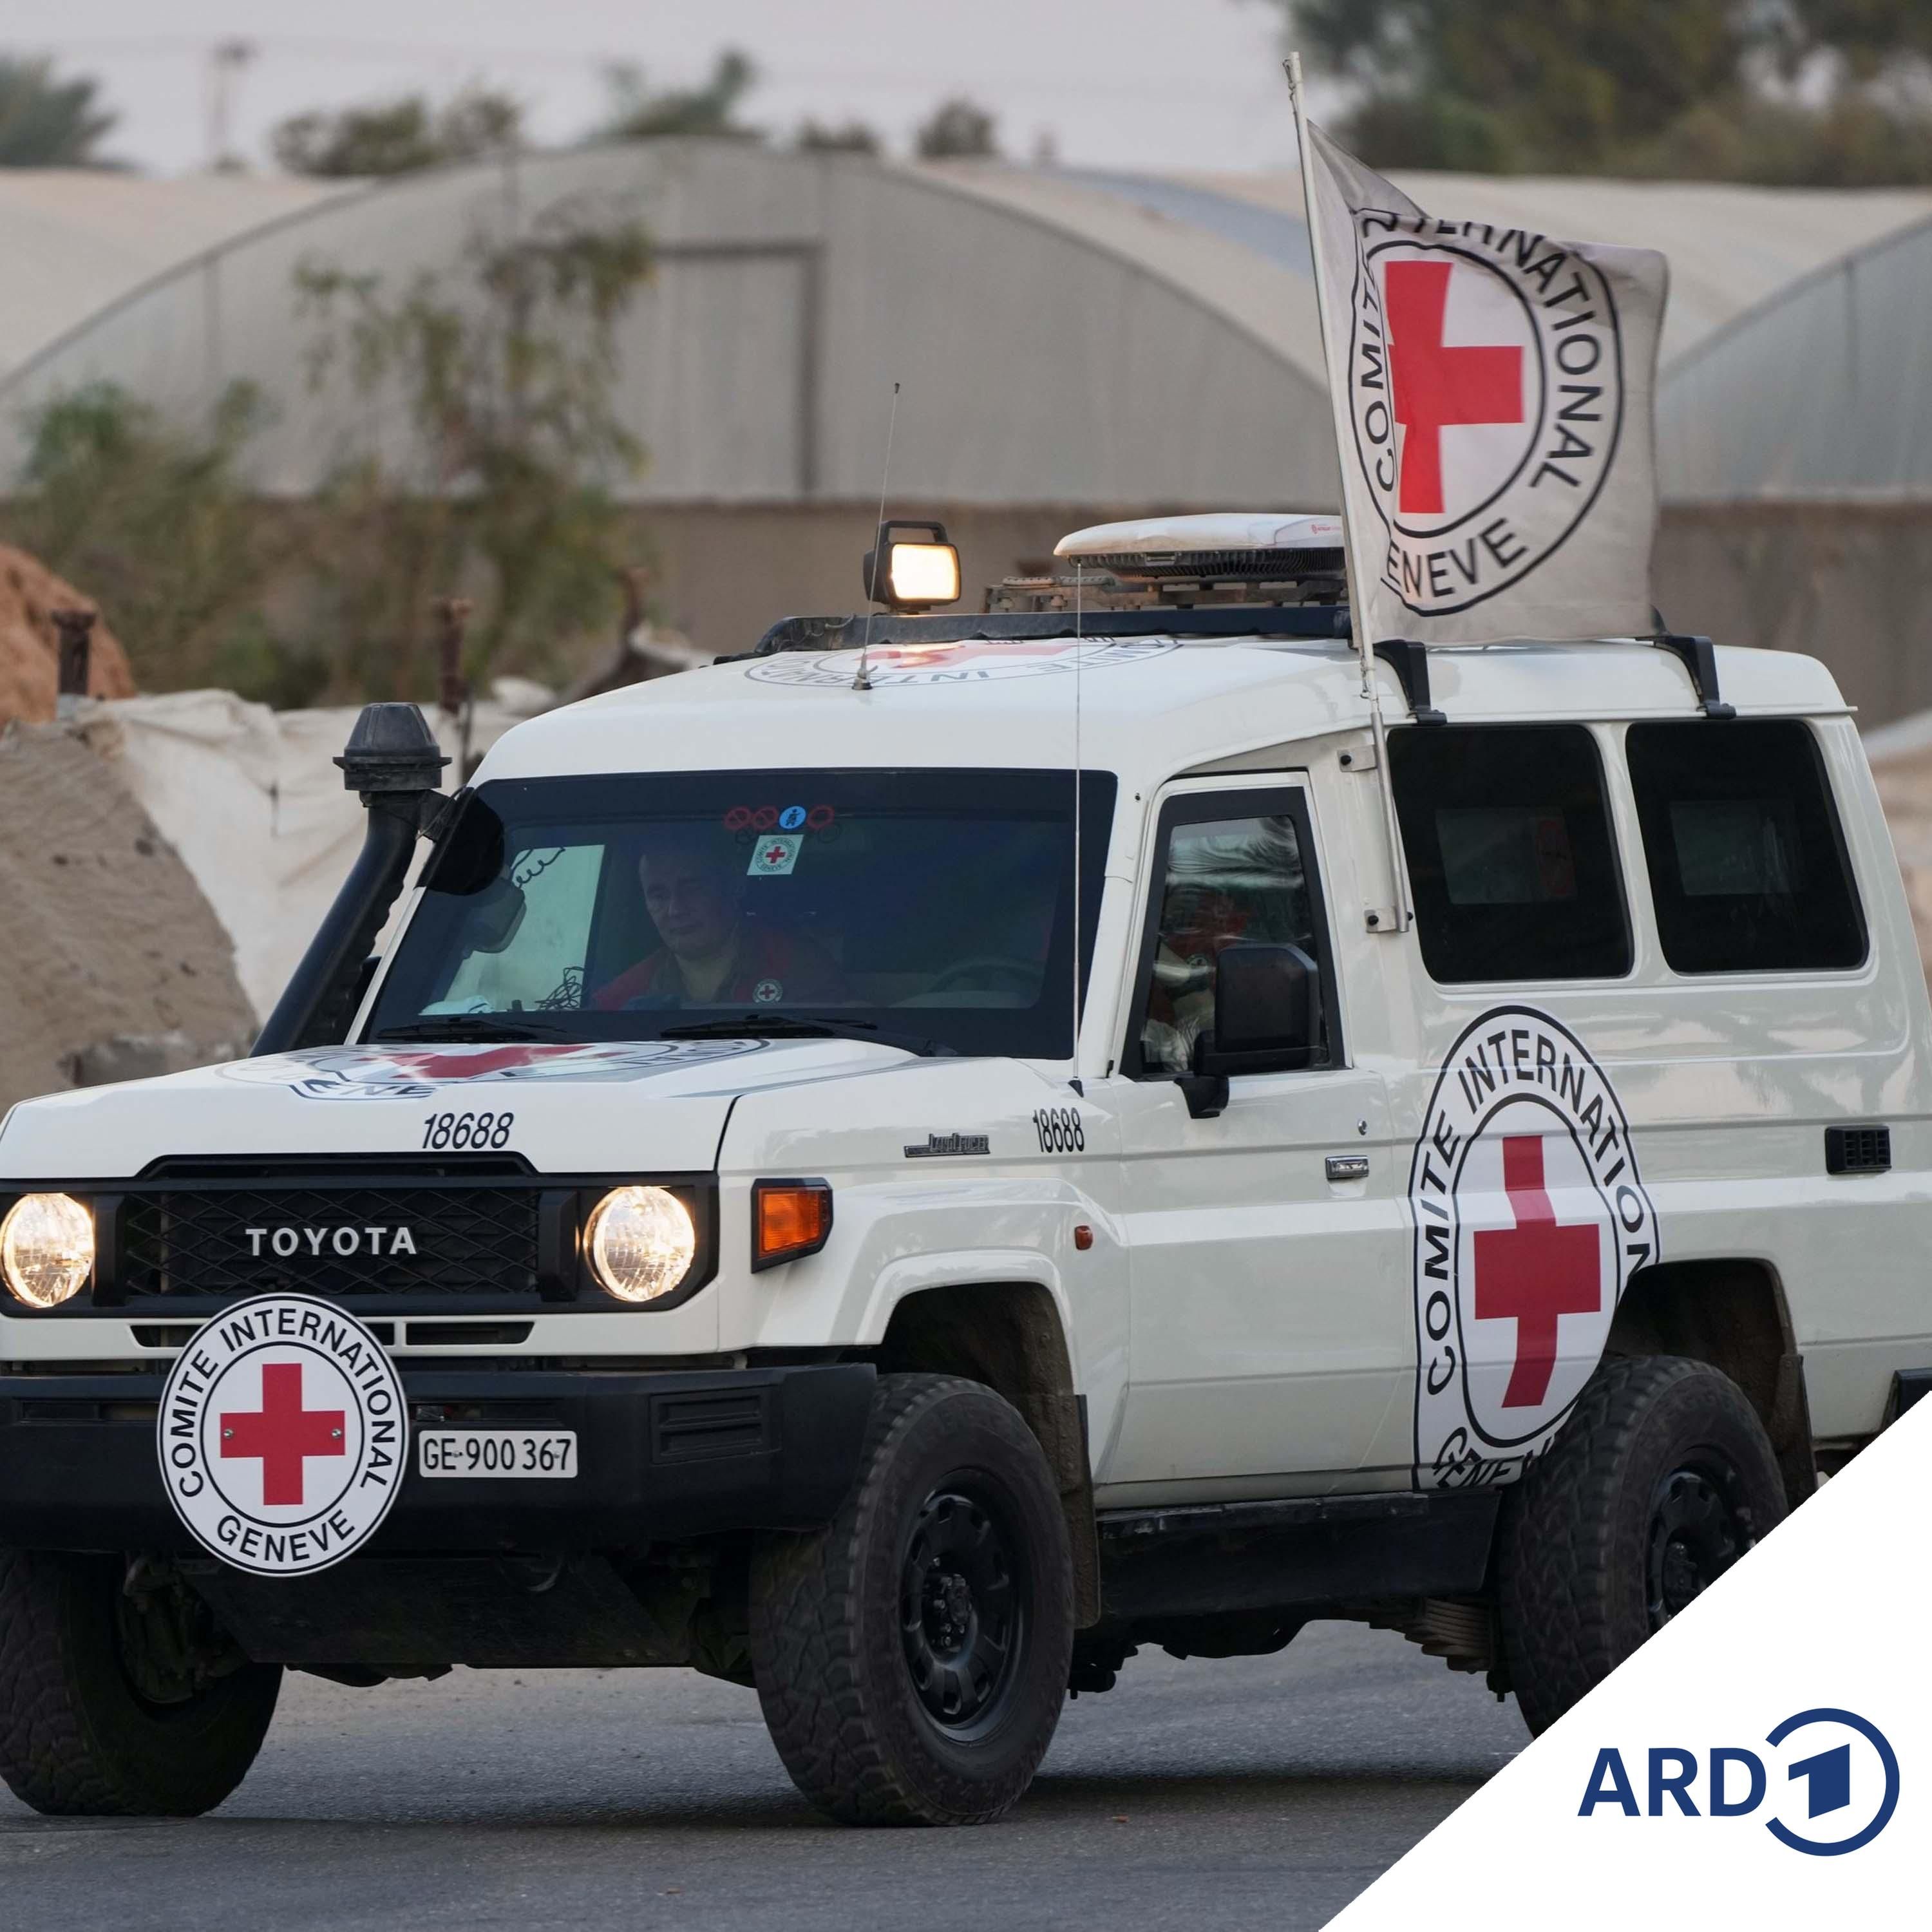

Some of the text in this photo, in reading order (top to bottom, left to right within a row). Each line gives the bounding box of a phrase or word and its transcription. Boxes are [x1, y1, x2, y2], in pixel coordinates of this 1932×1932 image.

[1387, 517, 1529, 598] ENEVE
[422, 1112, 514, 1150] 18688
[1032, 1107, 1084, 1153] 18688
[245, 1227, 417, 1256] TOYOTA
[1425, 1110, 1461, 1395] COMITE
[170, 1308, 395, 1497] COMITE INTERNATIONAL
[522, 1438, 571, 1471] 367
[217, 1510, 355, 1562] GENEVE
